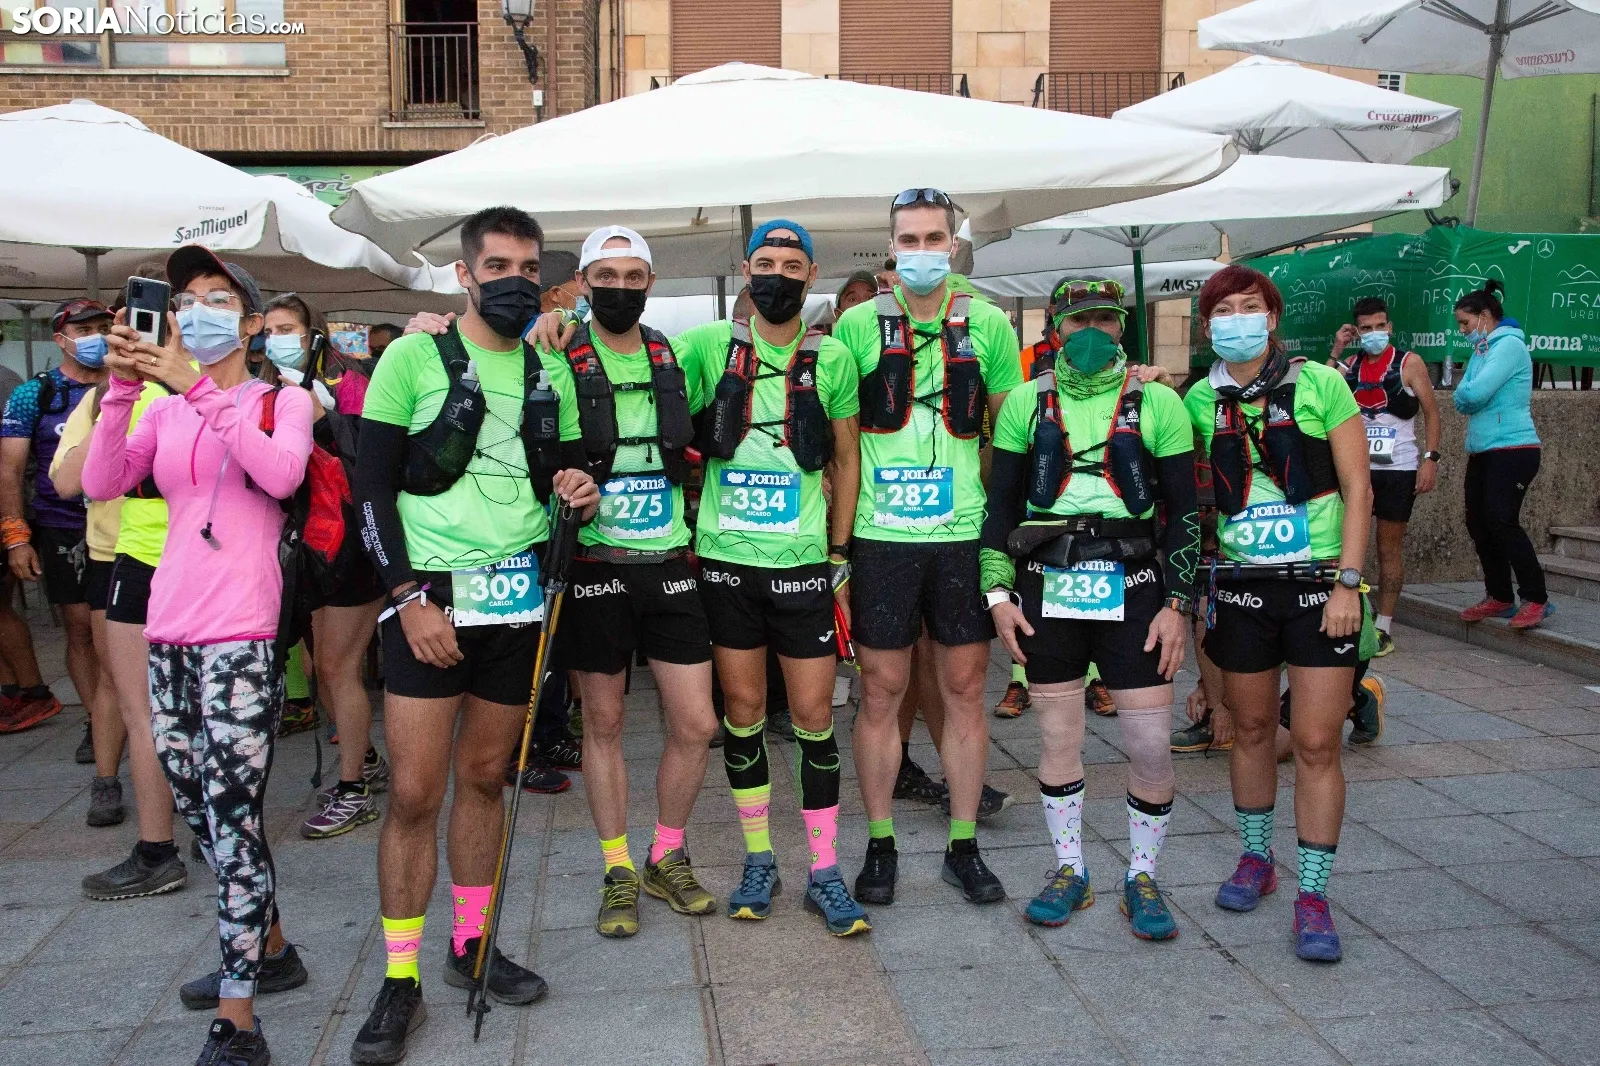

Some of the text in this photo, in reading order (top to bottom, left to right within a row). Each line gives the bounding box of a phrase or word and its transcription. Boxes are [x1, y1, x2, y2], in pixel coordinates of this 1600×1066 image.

[1452, 339, 1476, 349] Madurg
[613, 494, 663, 519] 275
[732, 487, 787, 512] 334
[887, 483, 940, 506] 282
[1236, 519, 1295, 546] 370
[469, 573, 531, 602] 309
[1056, 574, 1112, 599] 236
[1298, 590, 1332, 608] URB
